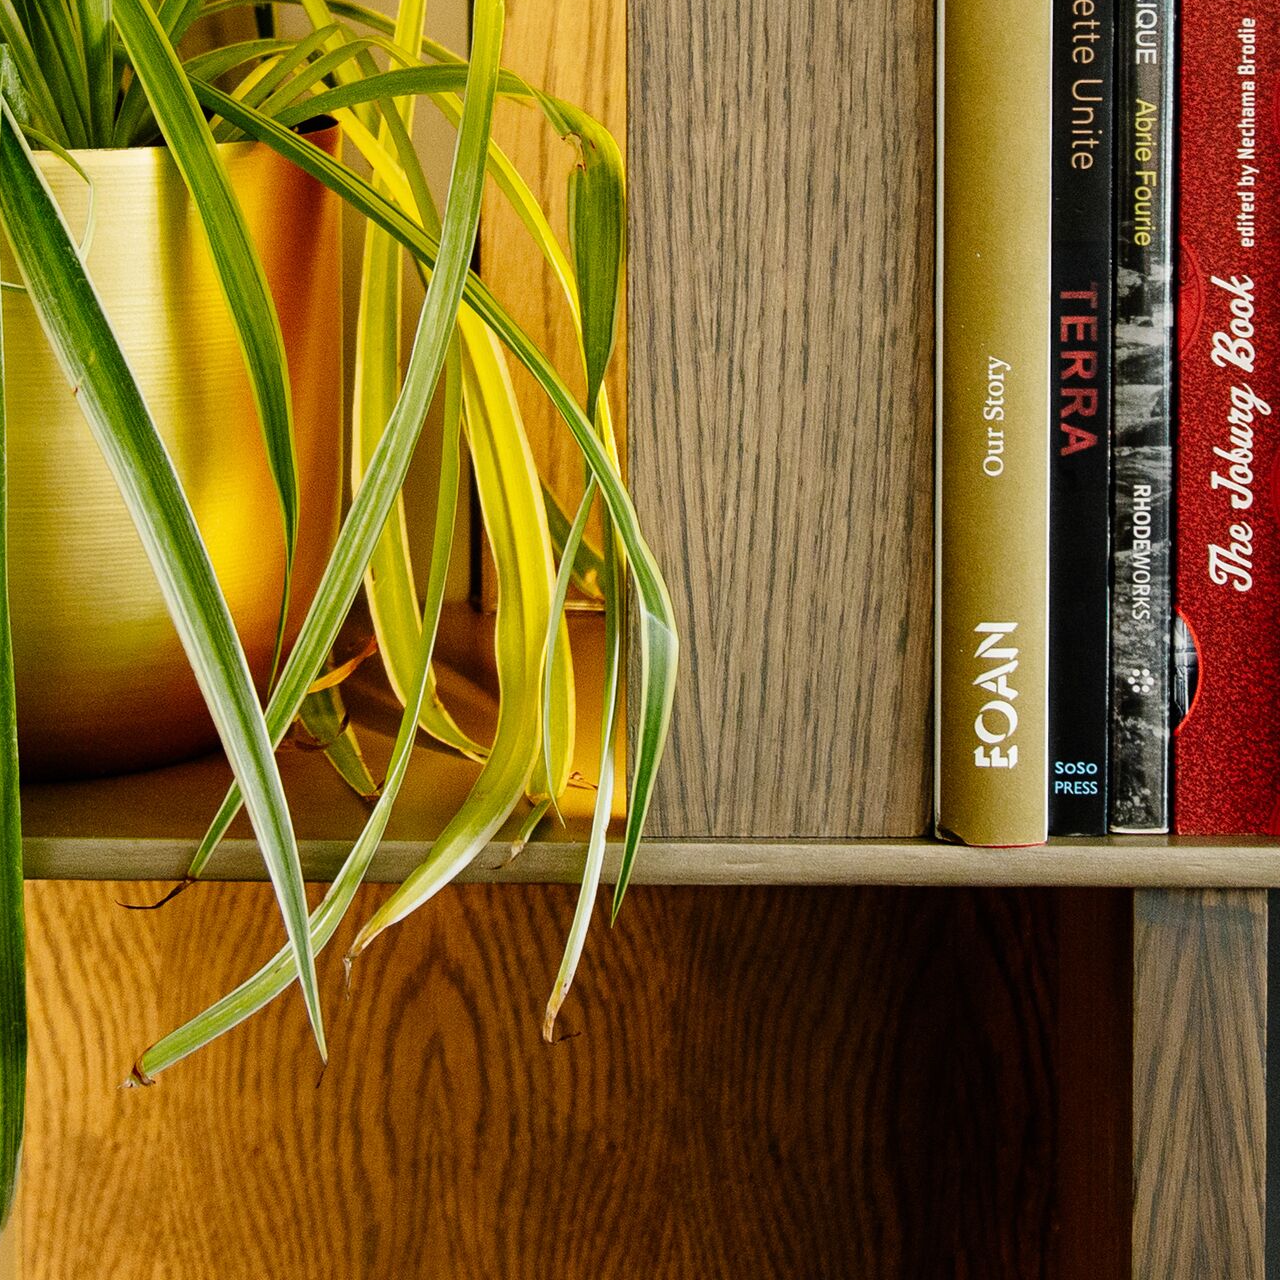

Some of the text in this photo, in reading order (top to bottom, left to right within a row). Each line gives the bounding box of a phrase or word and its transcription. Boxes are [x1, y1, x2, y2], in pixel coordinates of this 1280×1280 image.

[1071, 80, 1103, 170] Unite
[1135, 99, 1157, 162] Abrie
[1236, 17, 1261, 248] edited by Nechama Brodie
[1133, 170, 1157, 247] Fourie
[982, 355, 1011, 477] Our Story
[1059, 282, 1099, 458] TERRA
[1207, 274, 1272, 592] The Joburg Book
[1131, 483, 1152, 621] RHODEWORKS
[974, 622, 1018, 770] EOAN
[1054, 781, 1098, 795] PRESS
